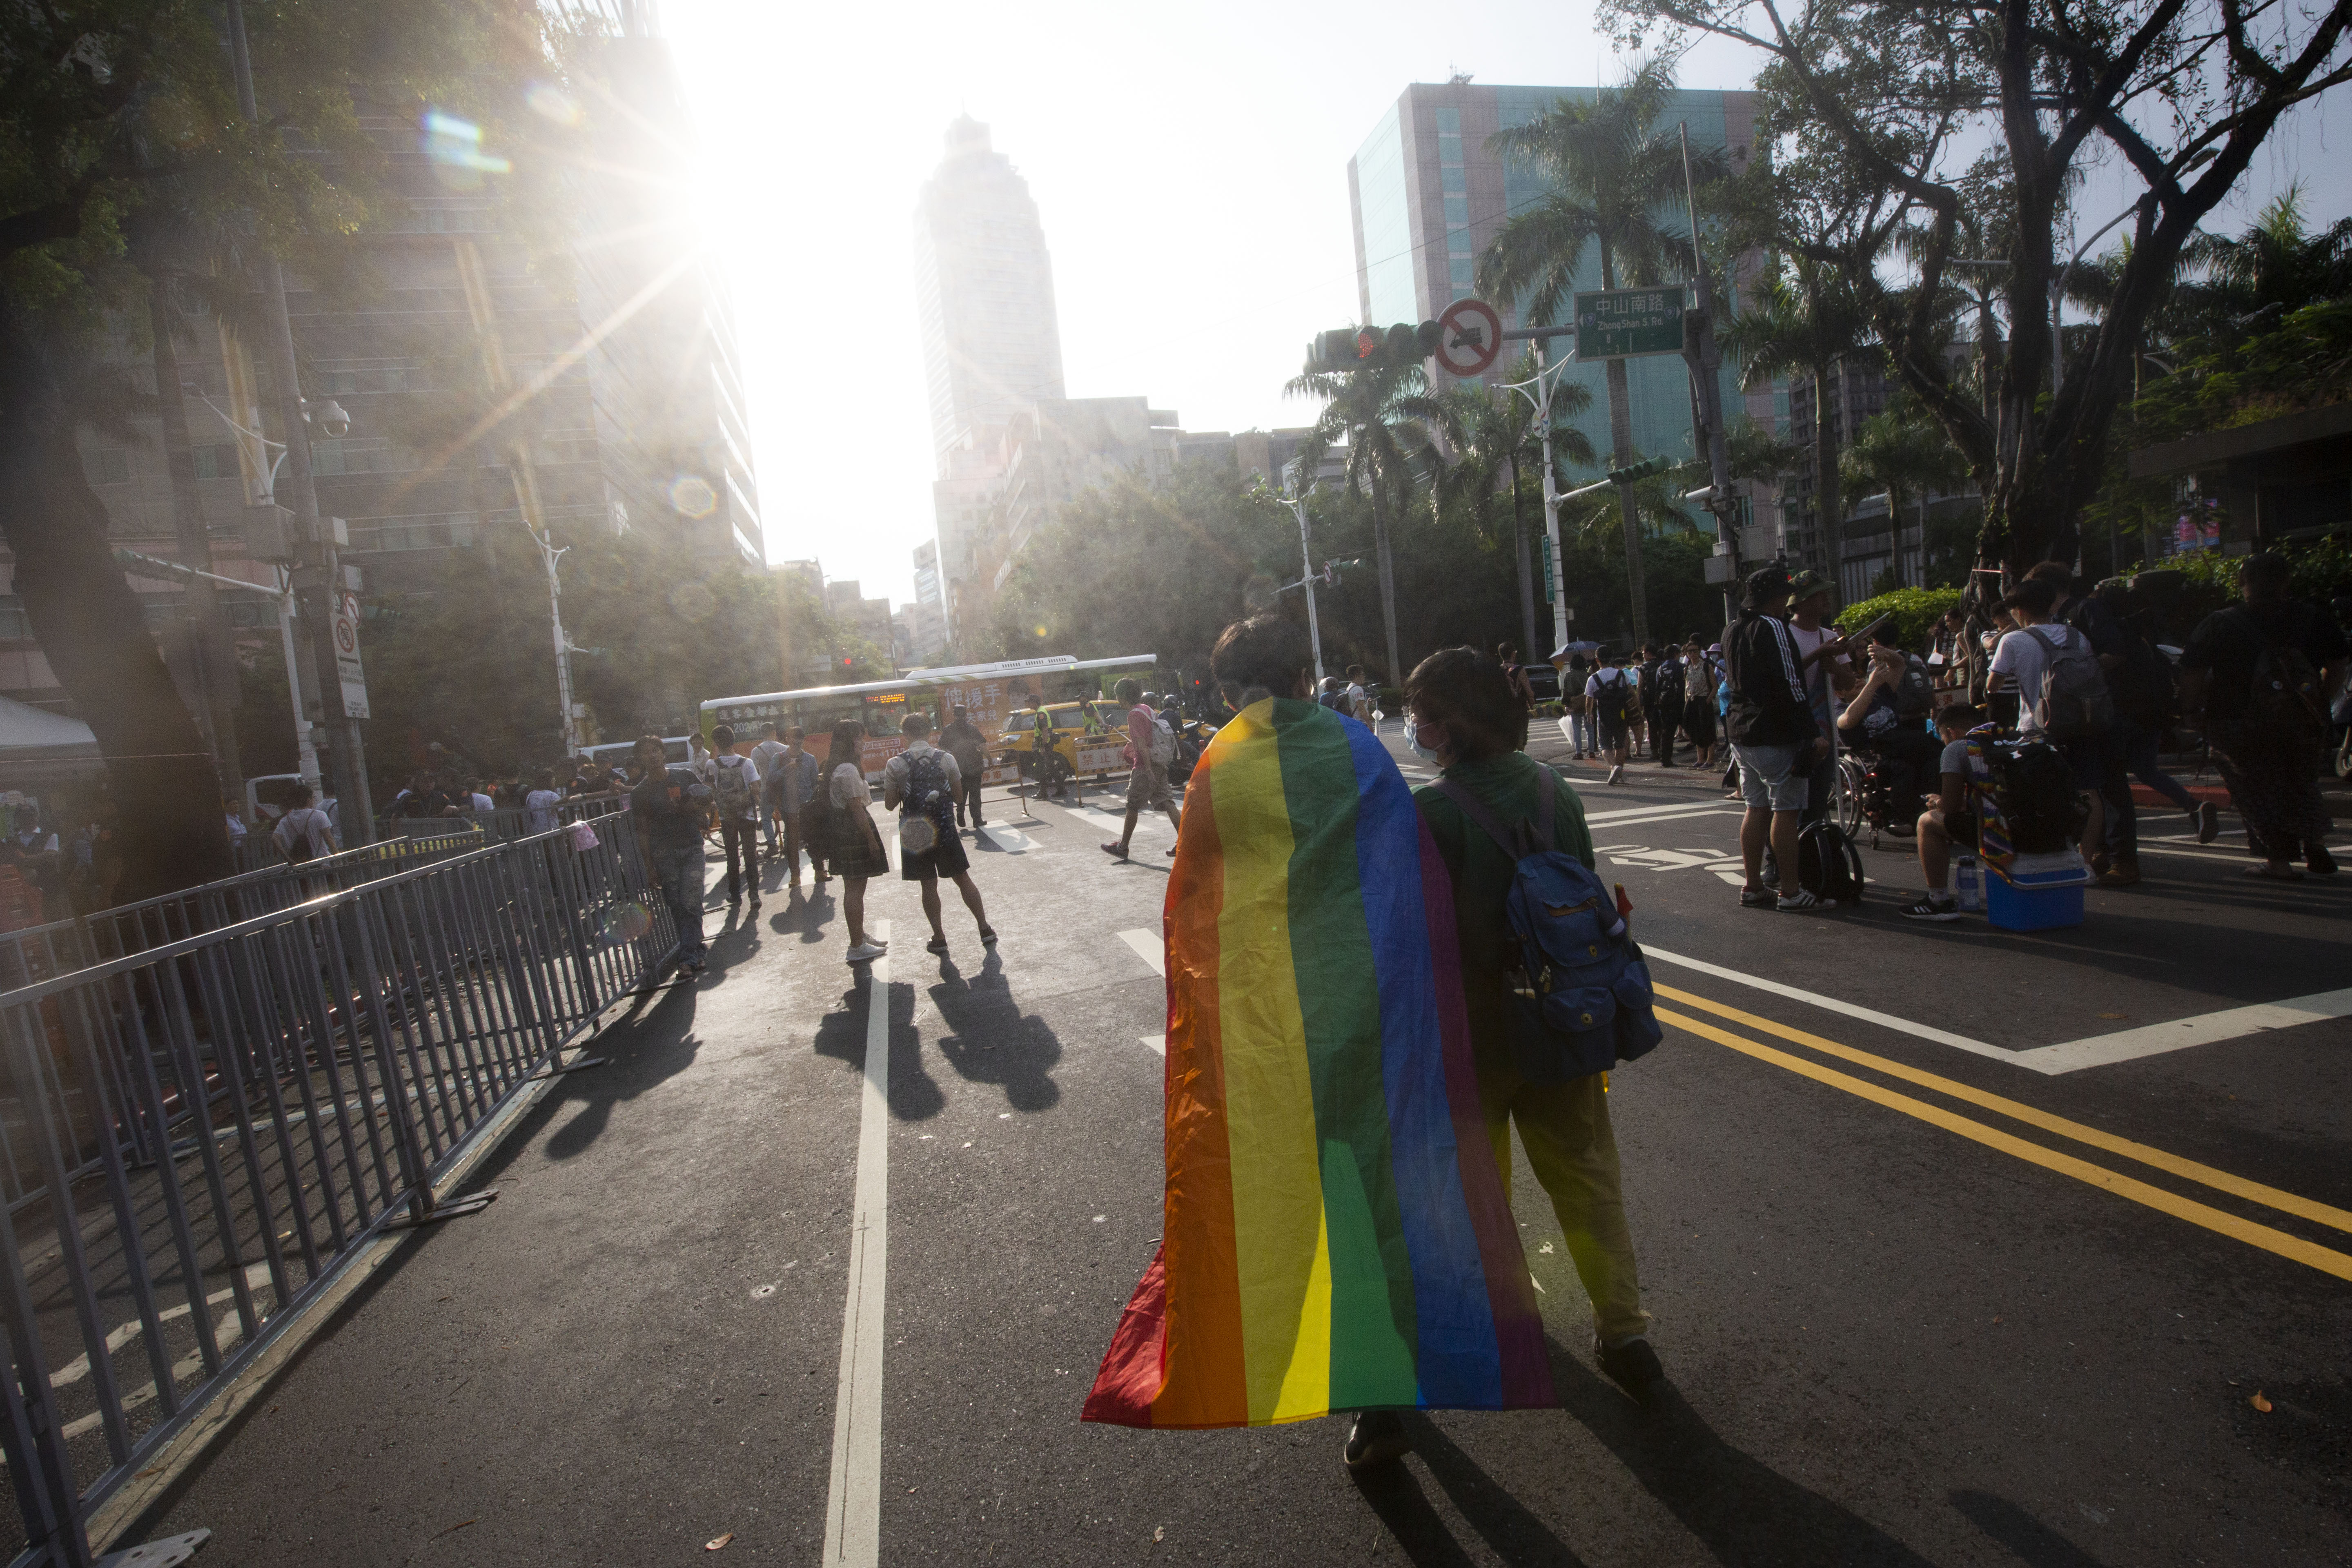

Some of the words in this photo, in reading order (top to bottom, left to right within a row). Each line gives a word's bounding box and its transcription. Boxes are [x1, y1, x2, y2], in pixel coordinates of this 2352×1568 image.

[1597, 294, 1663, 316] 中山南路
[1651, 316, 1663, 326] Rd.
[1606, 334, 1611, 343] 8
[944, 684, 1001, 709] 伸援手
[960, 709, 998, 723] 失家兒
[1082, 751, 1125, 766] 禁止停
